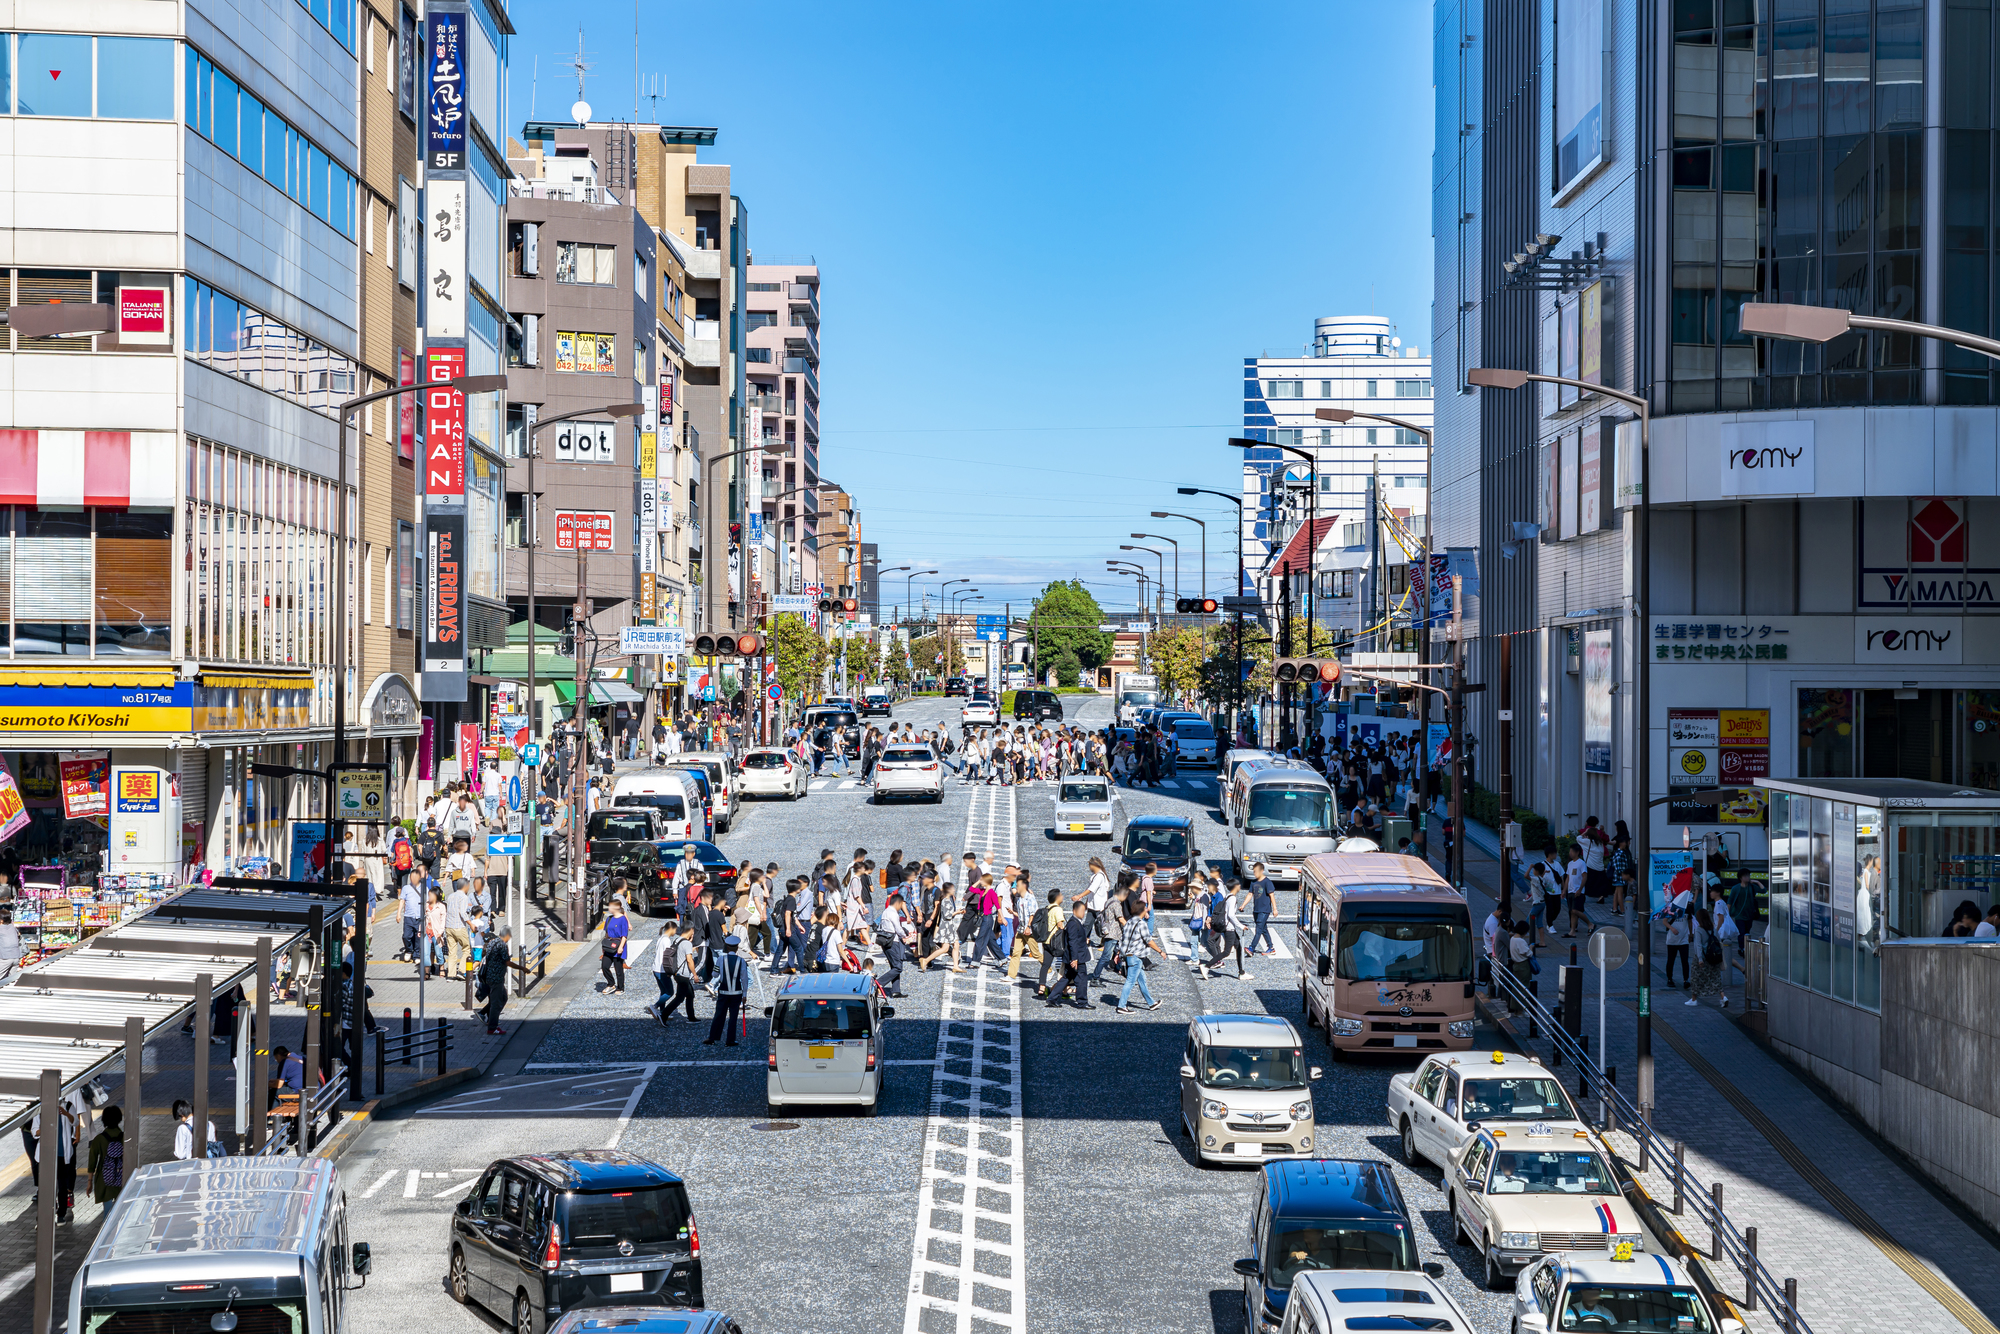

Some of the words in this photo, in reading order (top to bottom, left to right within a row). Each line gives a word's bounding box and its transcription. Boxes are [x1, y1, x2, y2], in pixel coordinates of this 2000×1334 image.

[436, 24, 446, 43] 和食
[448, 24, 458, 59] 炉ばたと
[436, 153, 458, 167] 5F
[453, 366, 462, 440] IALIAN
[430, 366, 450, 486] GOHAN
[559, 429, 610, 454] dot.
[1730, 447, 1802, 470] remy
[644, 493, 654, 515] dot.
[558, 518, 610, 530] iPhone修理
[440, 532, 451, 561] T.G.I.
[1882, 575, 1994, 601] YAMADA
[624, 632, 682, 642] JR町田駅前北
[1655, 624, 1789, 640] 生涯学習センター
[1867, 630, 1951, 651] remy
[1656, 644, 1788, 660] まちだ中央公民館
[441, 661, 447, 669] 2
[122, 693, 172, 703] NO.817号店
[0, 716, 64, 726] sumoto
[68, 714, 130, 726] KiYoshi
[1726, 719, 1762, 732] Denny's
[1809, 708, 1838, 727] HALLOWEEN
[1684, 755, 1704, 764] 390
[126, 775, 152, 797] 薬
[10, 800, 23, 812] OFF
[1385, 988, 1432, 1002] 万葉の湯
